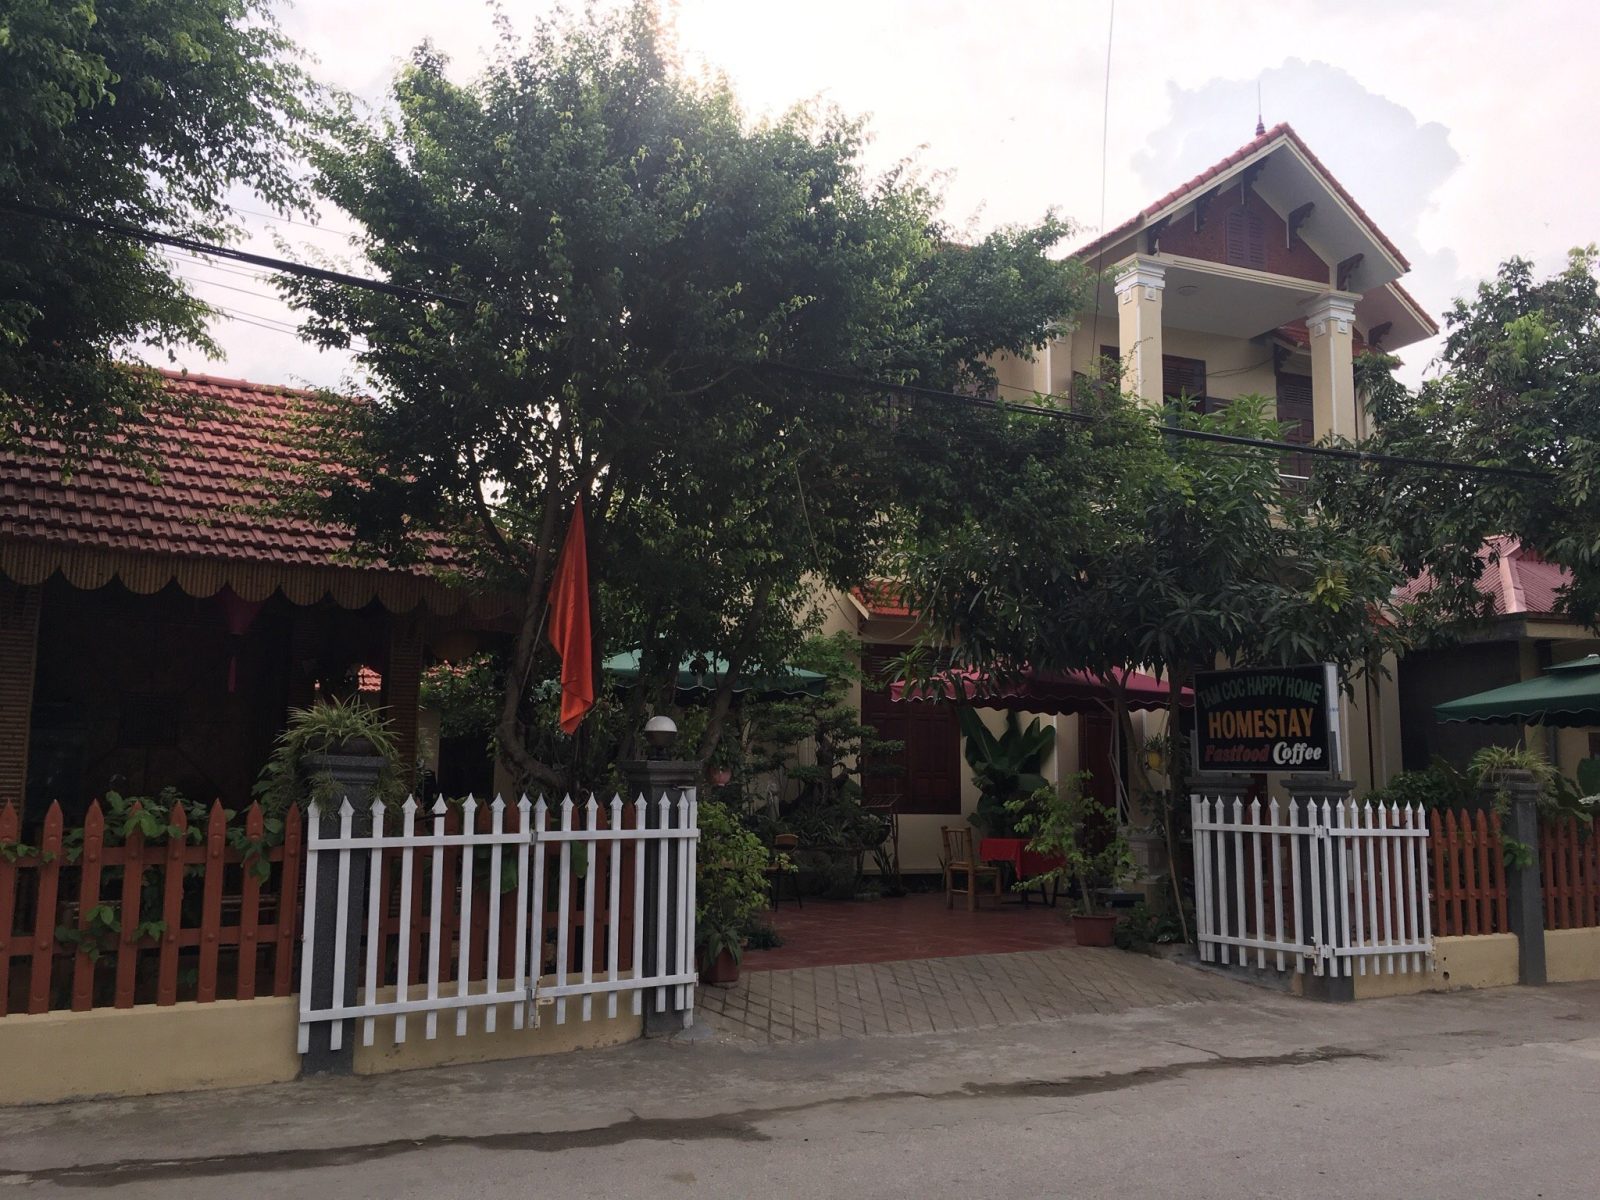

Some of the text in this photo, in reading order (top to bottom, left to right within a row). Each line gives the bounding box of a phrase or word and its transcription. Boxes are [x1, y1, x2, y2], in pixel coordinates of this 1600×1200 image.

[1199, 675, 1322, 709] TAM COC HAPPY HOME
[1208, 708, 1314, 739] HOMESTAY
[1204, 741, 1322, 765] Fastfood Coffee
